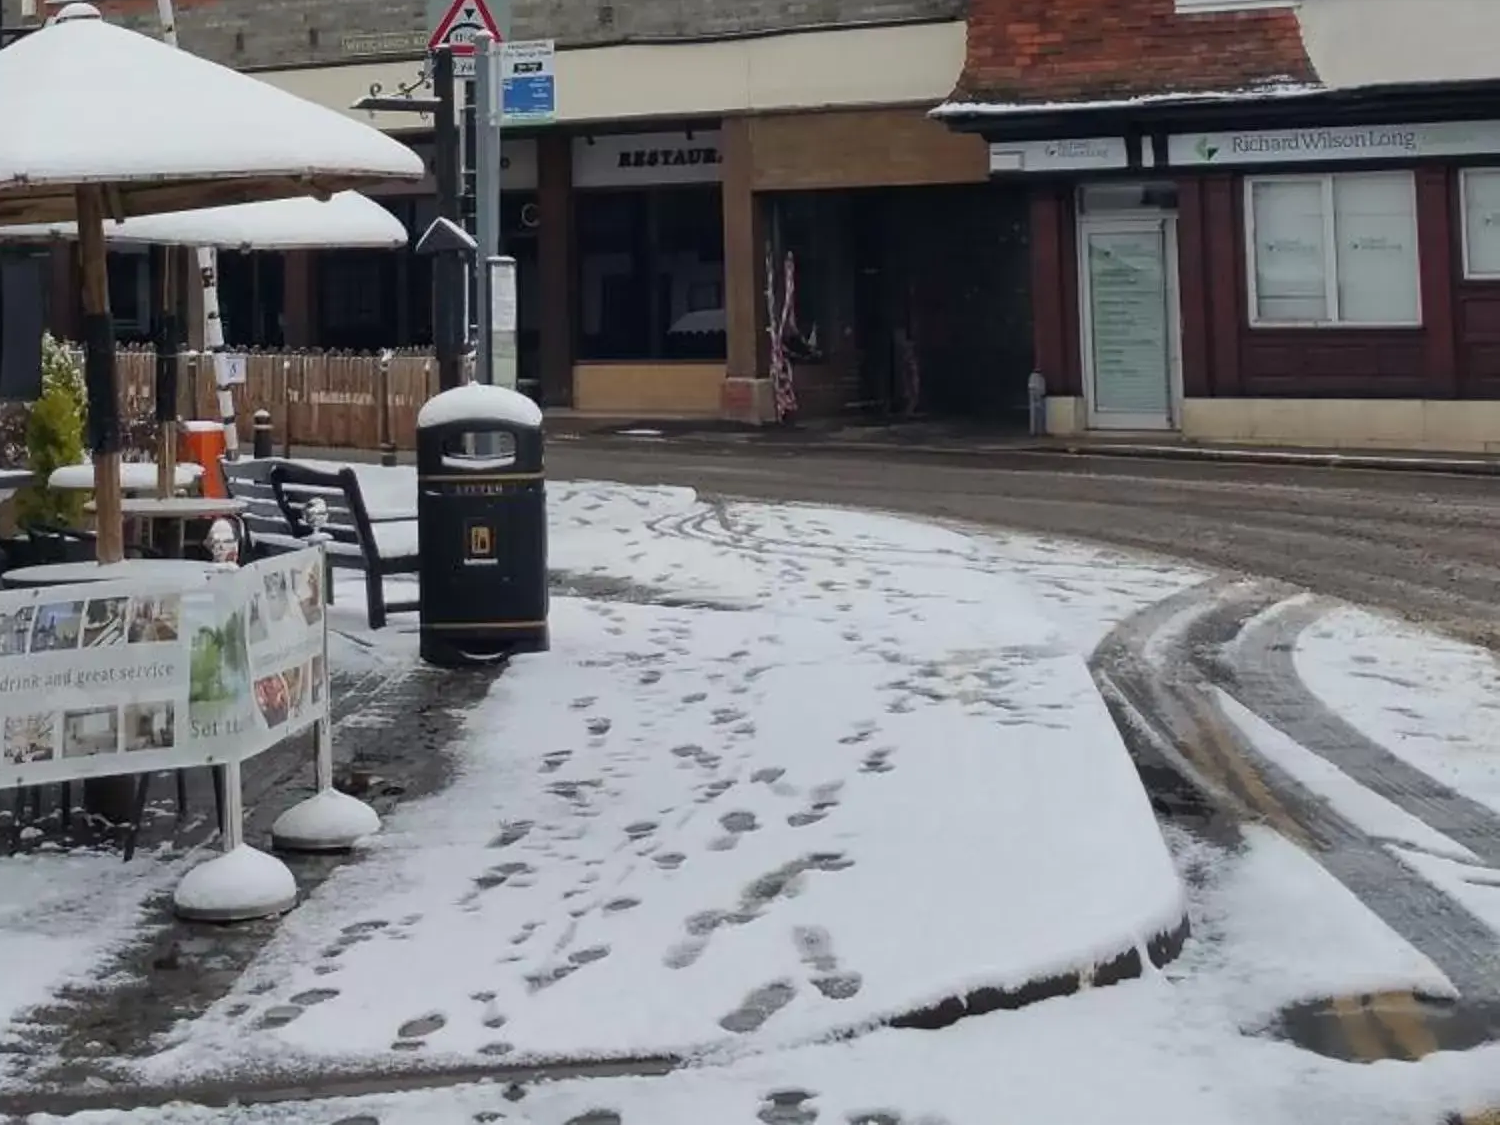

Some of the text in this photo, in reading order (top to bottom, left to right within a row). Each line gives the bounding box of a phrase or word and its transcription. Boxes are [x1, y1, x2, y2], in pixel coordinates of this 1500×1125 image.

[0, 673, 40, 693] drink
[44, 668, 73, 688] and
[77, 667, 115, 688] great
[118, 662, 175, 680] service
